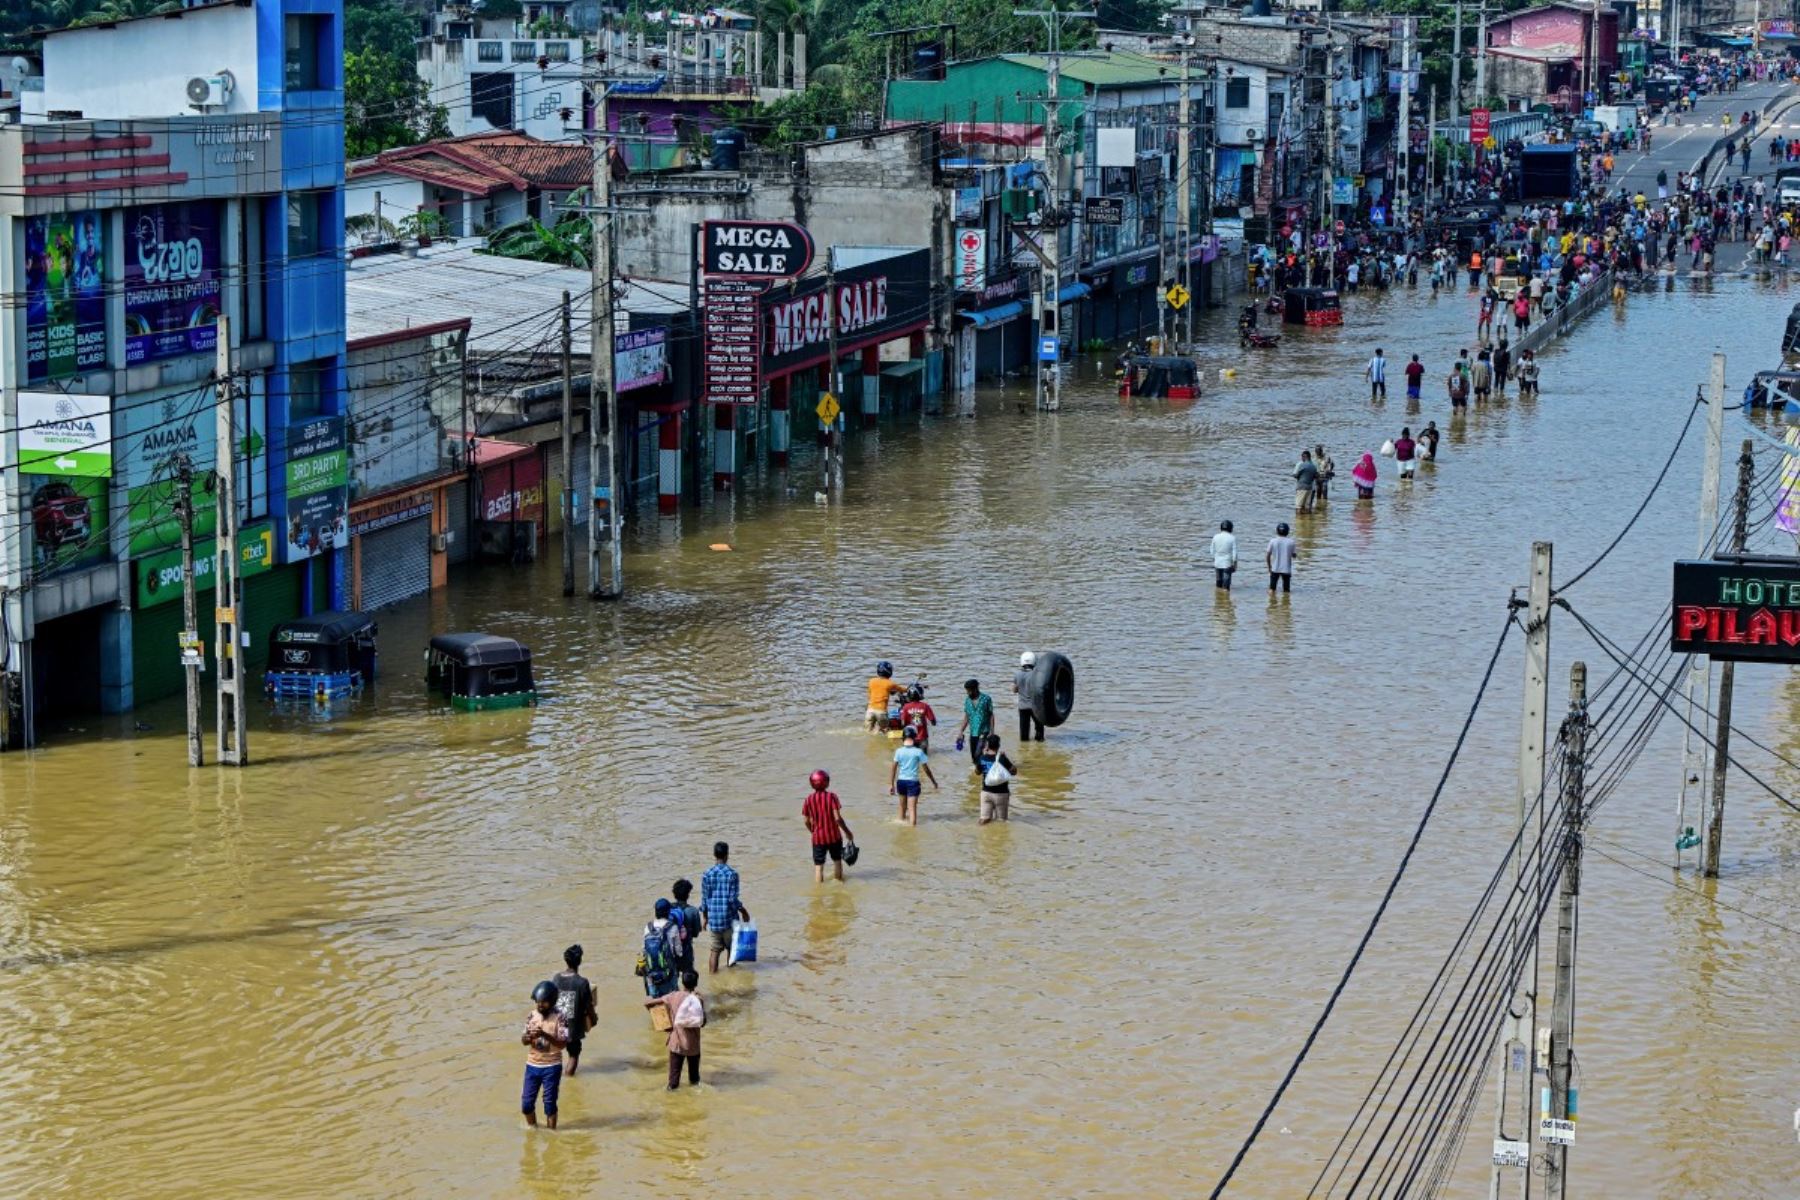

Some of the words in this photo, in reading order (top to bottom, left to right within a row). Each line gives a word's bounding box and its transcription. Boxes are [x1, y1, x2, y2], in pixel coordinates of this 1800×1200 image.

[715, 227, 792, 249] MEGA
[718, 252, 787, 273] SALE
[773, 293, 832, 357] MEGA
[840, 277, 888, 334] SALE
[48, 324, 75, 339] KIDS
[77, 331, 105, 345] BASIC
[48, 346, 75, 359] CLASS
[77, 352, 105, 365] CLASS
[35, 419, 95, 432] AMANA
[142, 424, 198, 452] AMANA
[312, 454, 340, 476] PARTY
[1718, 577, 1800, 606] HOTE
